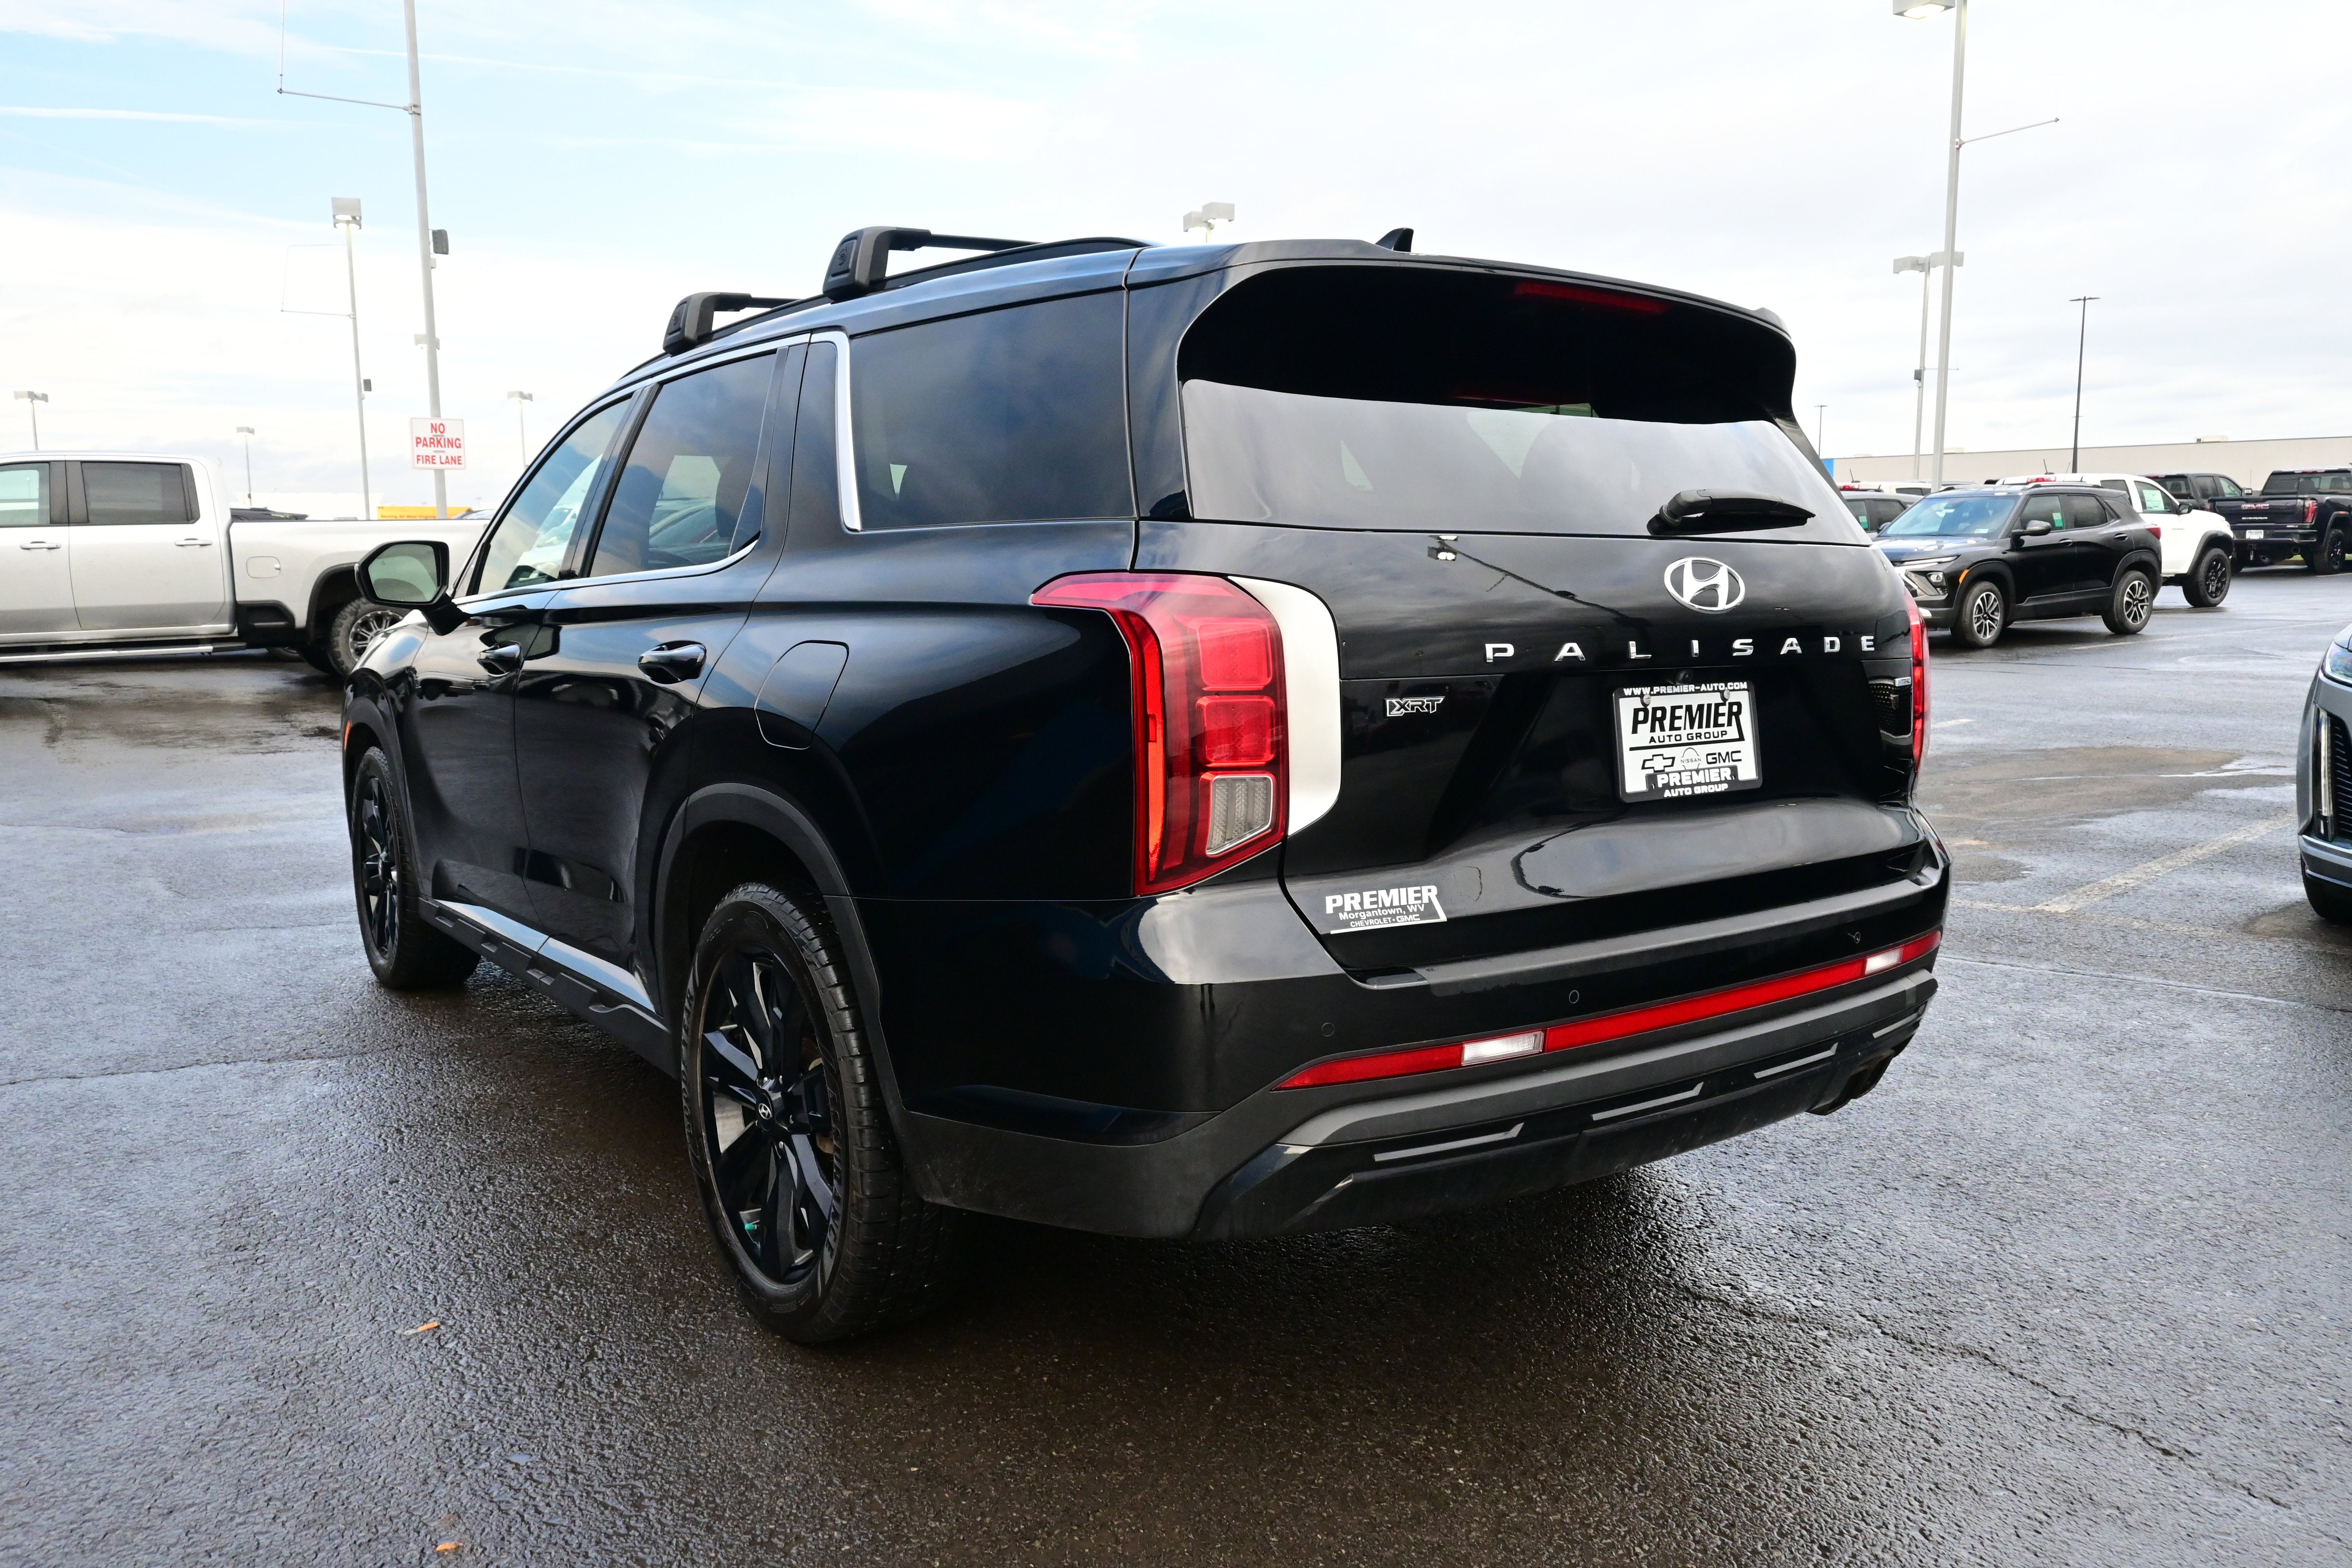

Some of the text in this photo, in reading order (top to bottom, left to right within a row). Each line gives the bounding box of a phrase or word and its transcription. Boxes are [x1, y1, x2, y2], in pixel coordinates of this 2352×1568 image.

[430, 423, 445, 434] NO
[415, 436, 462, 449] PARKING
[416, 455, 462, 465] FIRE LANE
[1484, 635, 1875, 663] PALISADE
[1623, 681, 1748, 696] WWW.PREMIER-AUTO.COM
[1388, 697, 1445, 716] XRT
[1631, 701, 1743, 735] PREMIER
[1649, 730, 1728, 744] AUTO GROUP
[1706, 750, 1742, 765] GMC
[1657, 767, 1732, 788] PREMIER
[1663, 783, 1729, 798] AUTO GROUP
[1325, 885, 1438, 915] PREMIER
[1339, 904, 1425, 921] Morgantown, WV
[1350, 914, 1421, 928] CHEVROLET GMC
